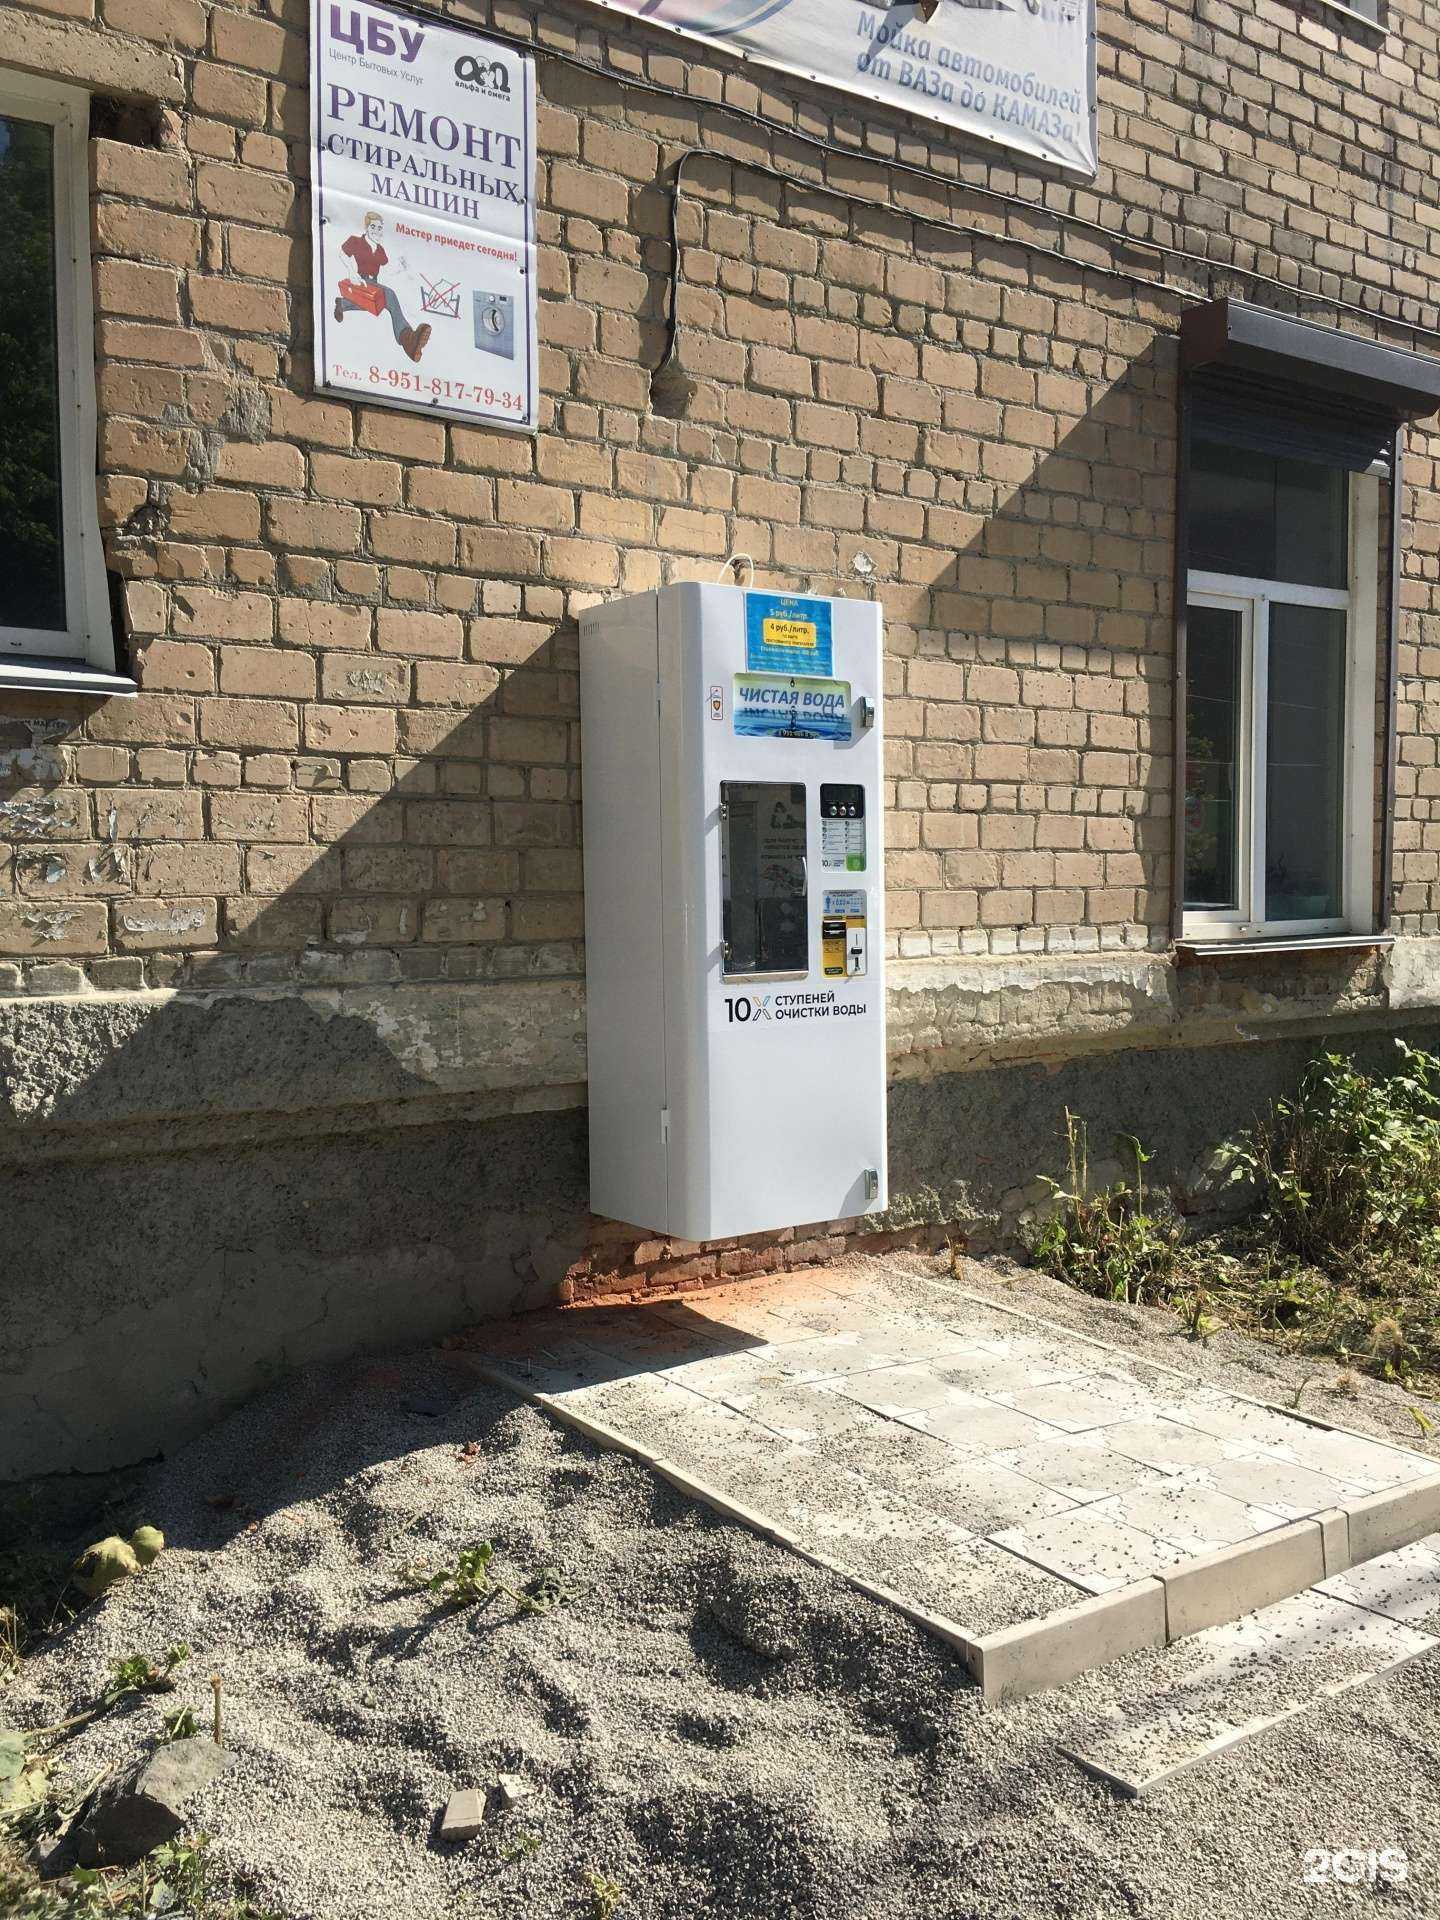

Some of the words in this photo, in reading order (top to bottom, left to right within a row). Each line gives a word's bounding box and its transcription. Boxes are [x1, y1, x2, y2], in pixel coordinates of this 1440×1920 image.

[330, 4, 425, 62] ЦБУ
[329, 48, 357, 65] Центр
[359, 57, 398, 78] Бытовых
[400, 70, 424, 85] Услуг
[857, 11, 931, 60] Мойка
[937, 46, 1081, 115] автомобилей
[455, 80, 480, 93] альфа
[487, 90, 511, 102] омега
[857, 52, 892, 80] от
[899, 59, 954, 103] ВАЗа
[960, 81, 986, 113] до
[992, 95, 1080, 143] КАМАЗа!
[327, 83, 521, 169] РЕМОНТ
[327, 133, 521, 203] СТИРАЛЬНЫХ
[371, 172, 480, 220] МАШИН
[395, 223, 433, 242] Мастер
[434, 234, 476, 253] приедет
[476, 243, 518, 262] сегодня!
[332, 364, 363, 381] Тел.
[369, 366, 523, 411] 8-951-817-79-34
[739, 687, 799, 706] ЧИСТАЯ
[803, 692, 845, 710] ВОДА
[775, 991, 835, 1006] СТУПЕНЕЙ
[775, 1007, 829, 1020] ОЧИСТКИ
[832, 1004, 867, 1017] ВОДЫ
